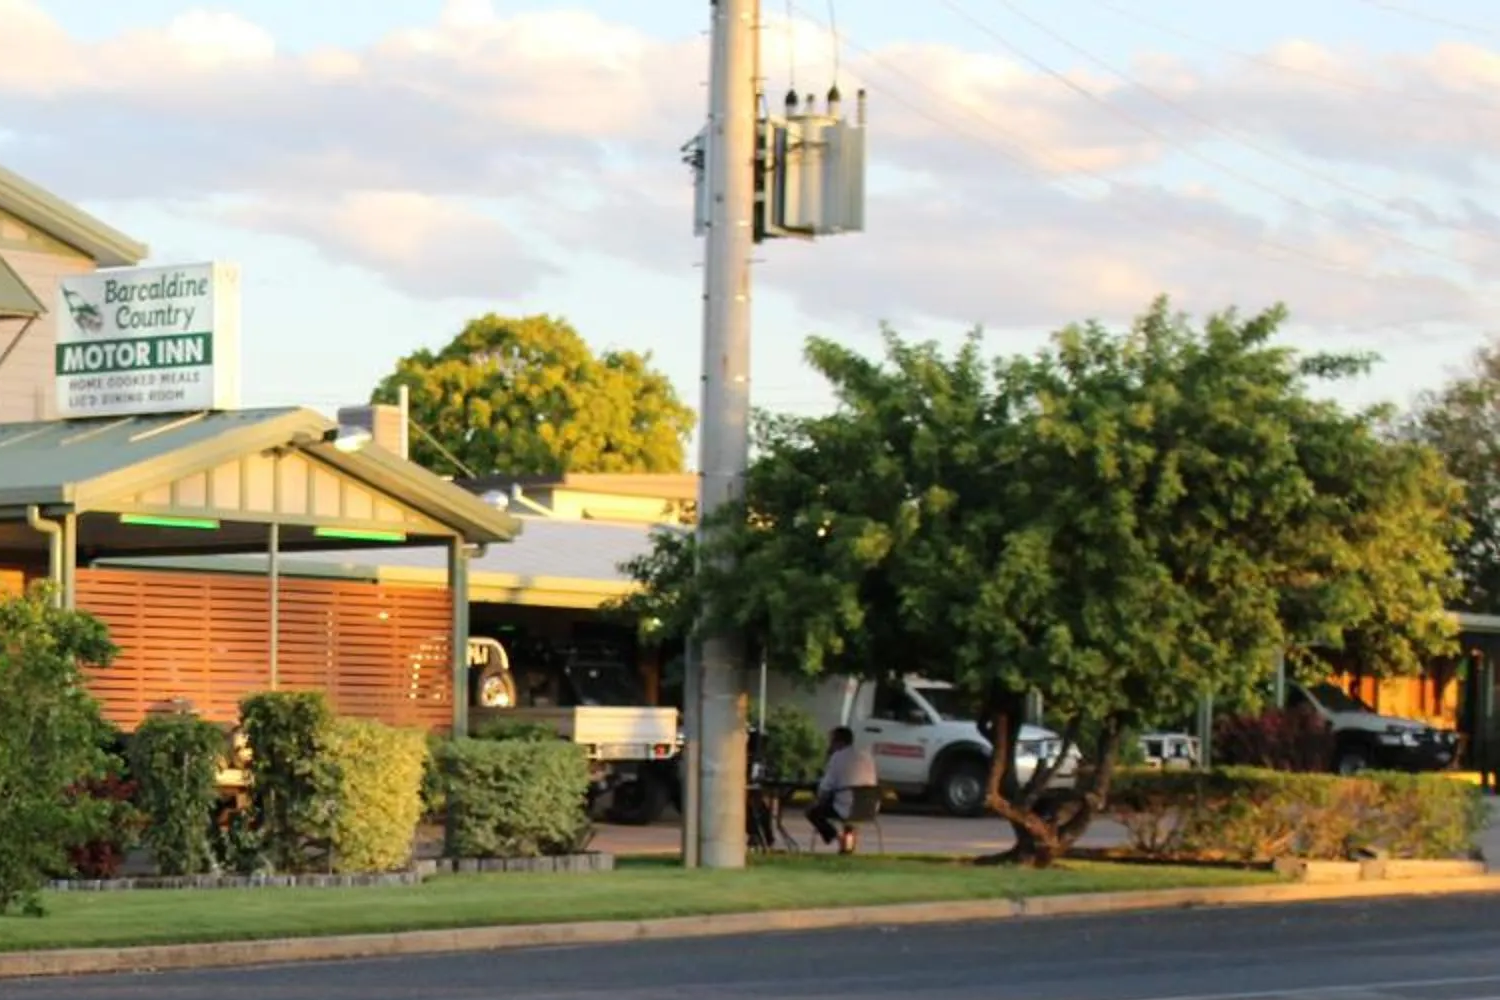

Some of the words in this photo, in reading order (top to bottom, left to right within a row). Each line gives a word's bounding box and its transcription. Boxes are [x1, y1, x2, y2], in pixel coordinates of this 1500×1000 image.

[105, 273, 208, 304] Barcaldine
[115, 305, 195, 331] Country
[63, 341, 151, 372] MOTOR
[157, 337, 204, 364] INN
[69, 377, 101, 392] HOME
[161, 371, 200, 384] MEALS
[150, 388, 185, 401] ROOM
